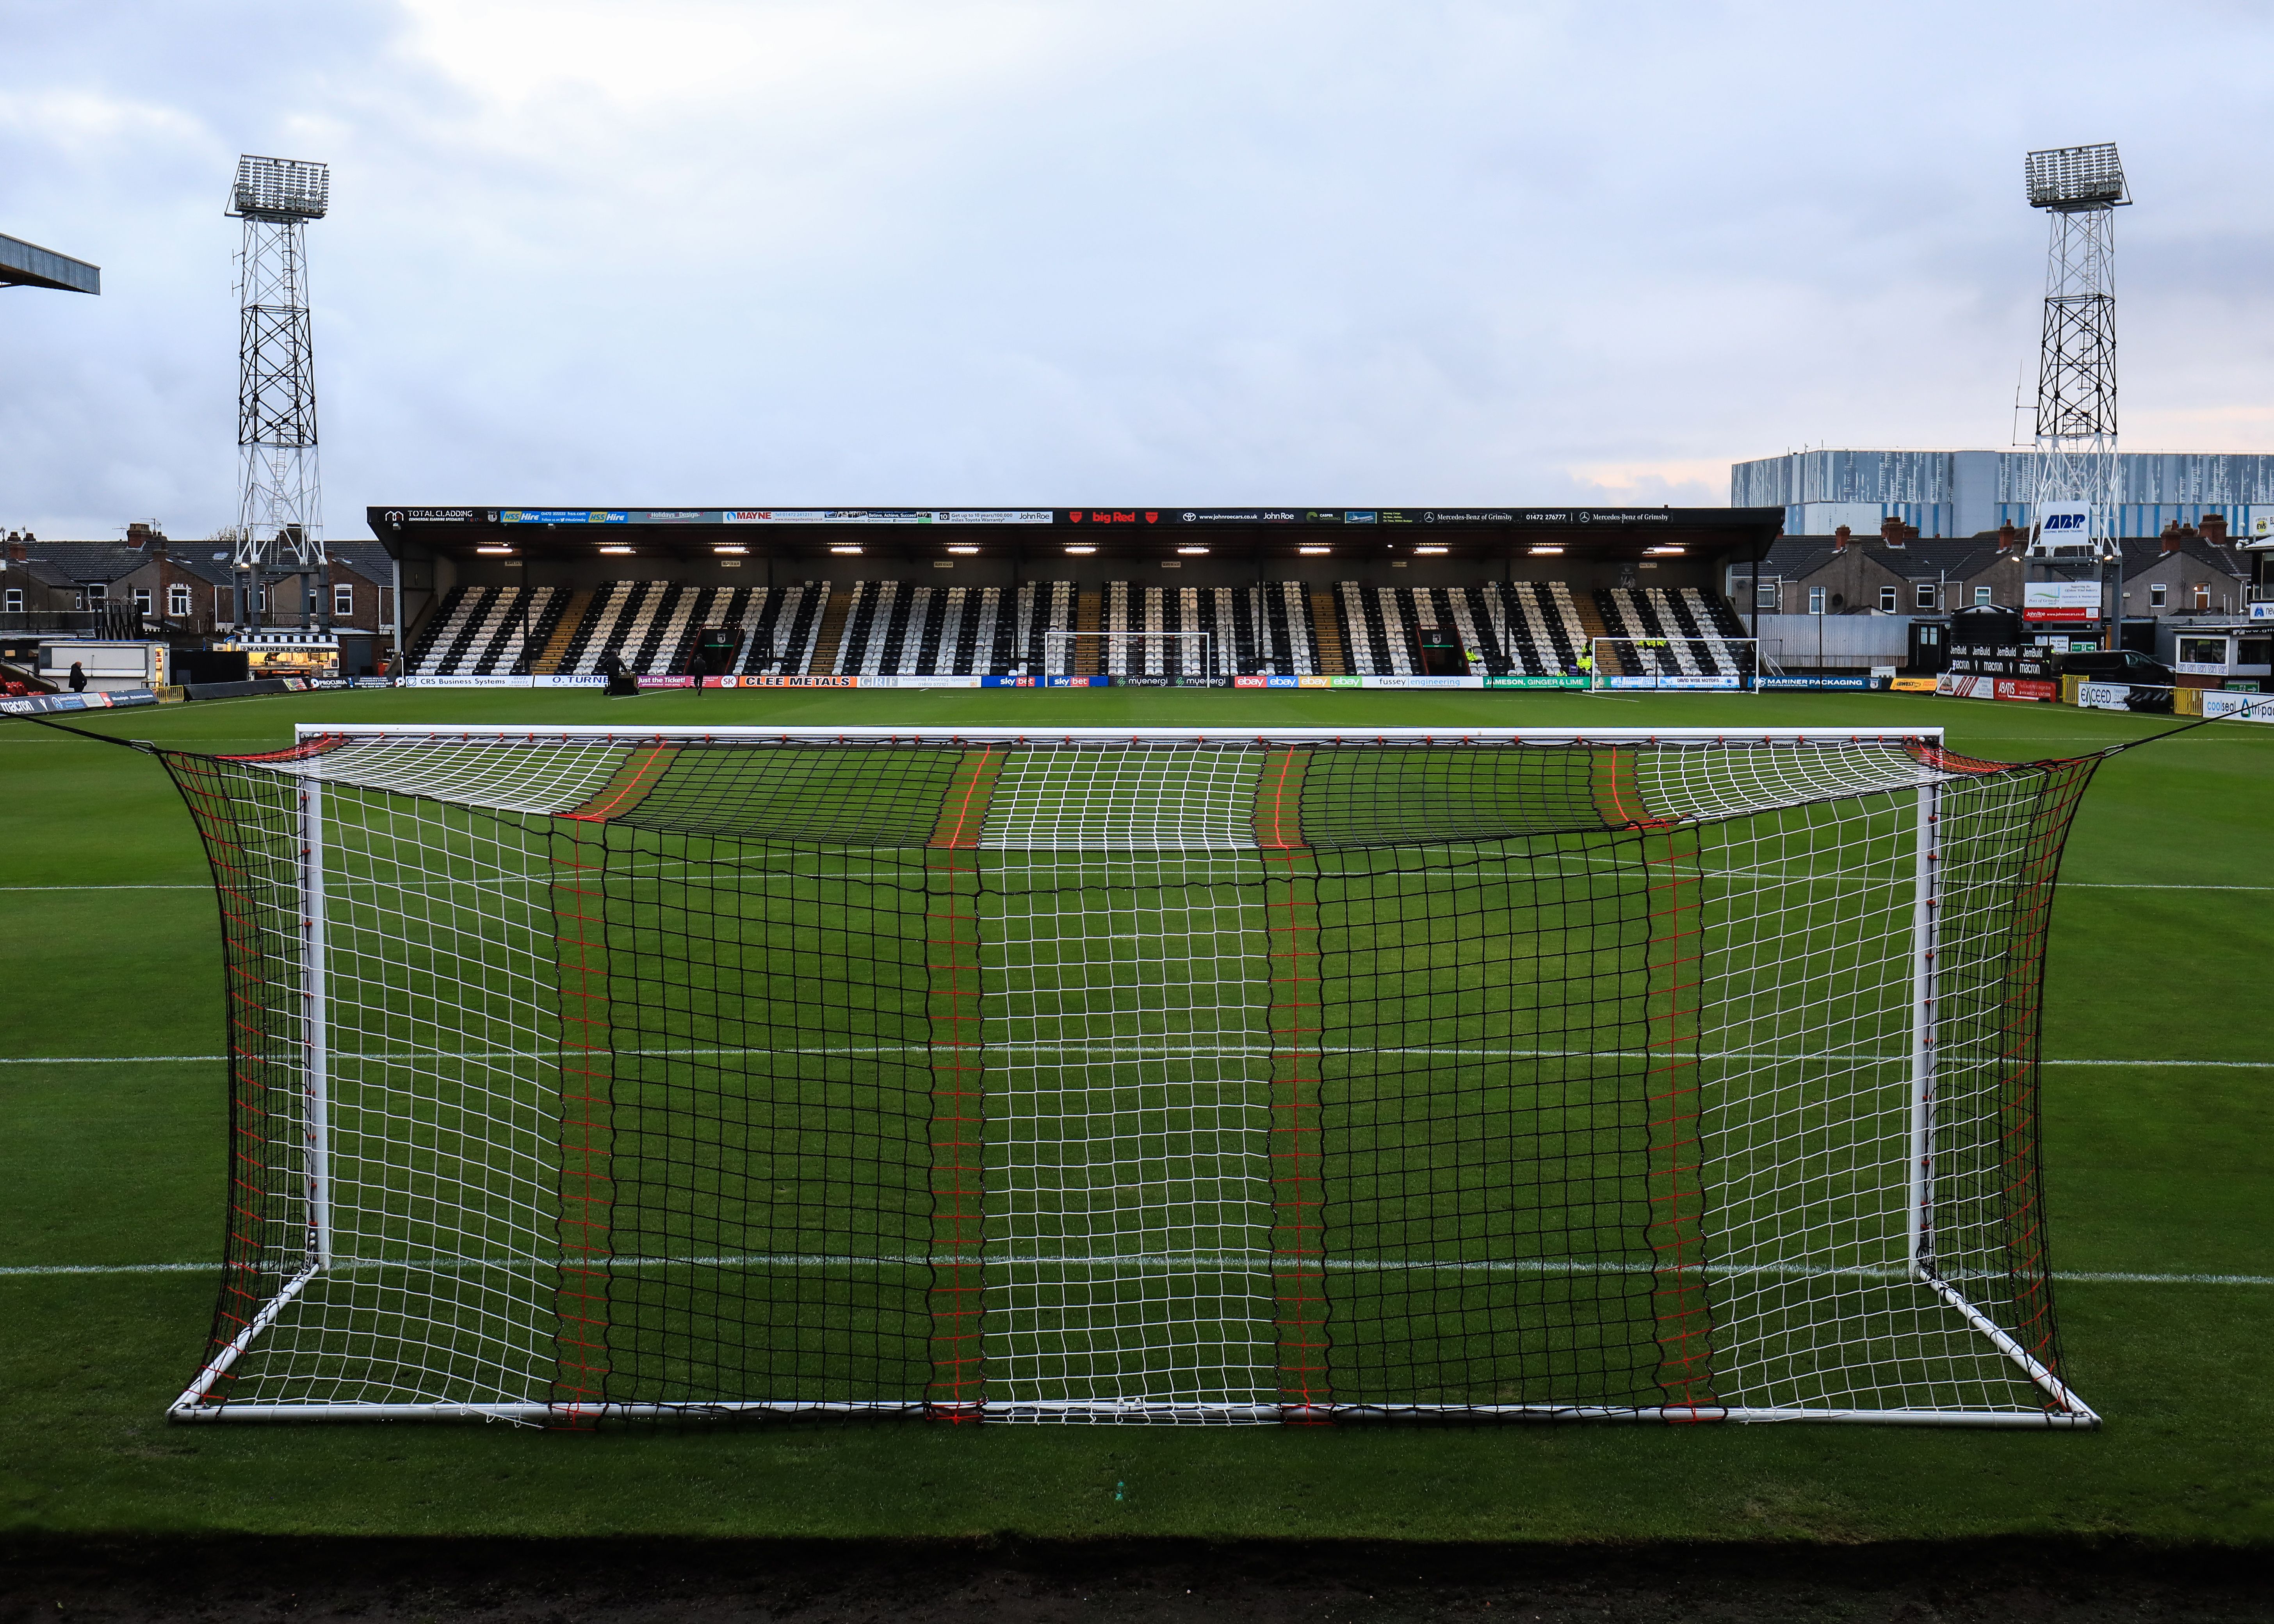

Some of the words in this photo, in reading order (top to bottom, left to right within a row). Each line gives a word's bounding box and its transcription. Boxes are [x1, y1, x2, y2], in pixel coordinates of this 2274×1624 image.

[1093, 512, 1111, 523] big
[1113, 512, 1135, 521] Red
[2044, 514, 2085, 529] ABP
[1950, 645, 1967, 655] JemBuild
[1972, 646, 1990, 656] JemBuild
[1996, 647, 2016, 657] JemBuild
[2023, 647, 2043, 658] JemBuild
[1953, 660, 1969, 670] macron
[1984, 661, 2003, 672] macron
[2019, 663, 2040, 674] macron
[746, 677, 784, 686] CLEE
[789, 677, 850, 686] METALS
[1000, 677, 1015, 686] sky
[1054, 677, 1070, 686] sky
[1128, 678, 1168, 687] myenergi
[1186, 678, 1226, 687] myenergi
[1237, 677, 1264, 687] ebay
[1270, 677, 1296, 687] ebay
[1301, 677, 1328, 687] ebay
[1333, 677, 1360, 687] ebay
[1379, 678, 1406, 686] fussey
[1998, 681, 2015, 695] ABATIS
[0, 700, 35, 713] macron
[2207, 700, 2236, 712] coolseal
